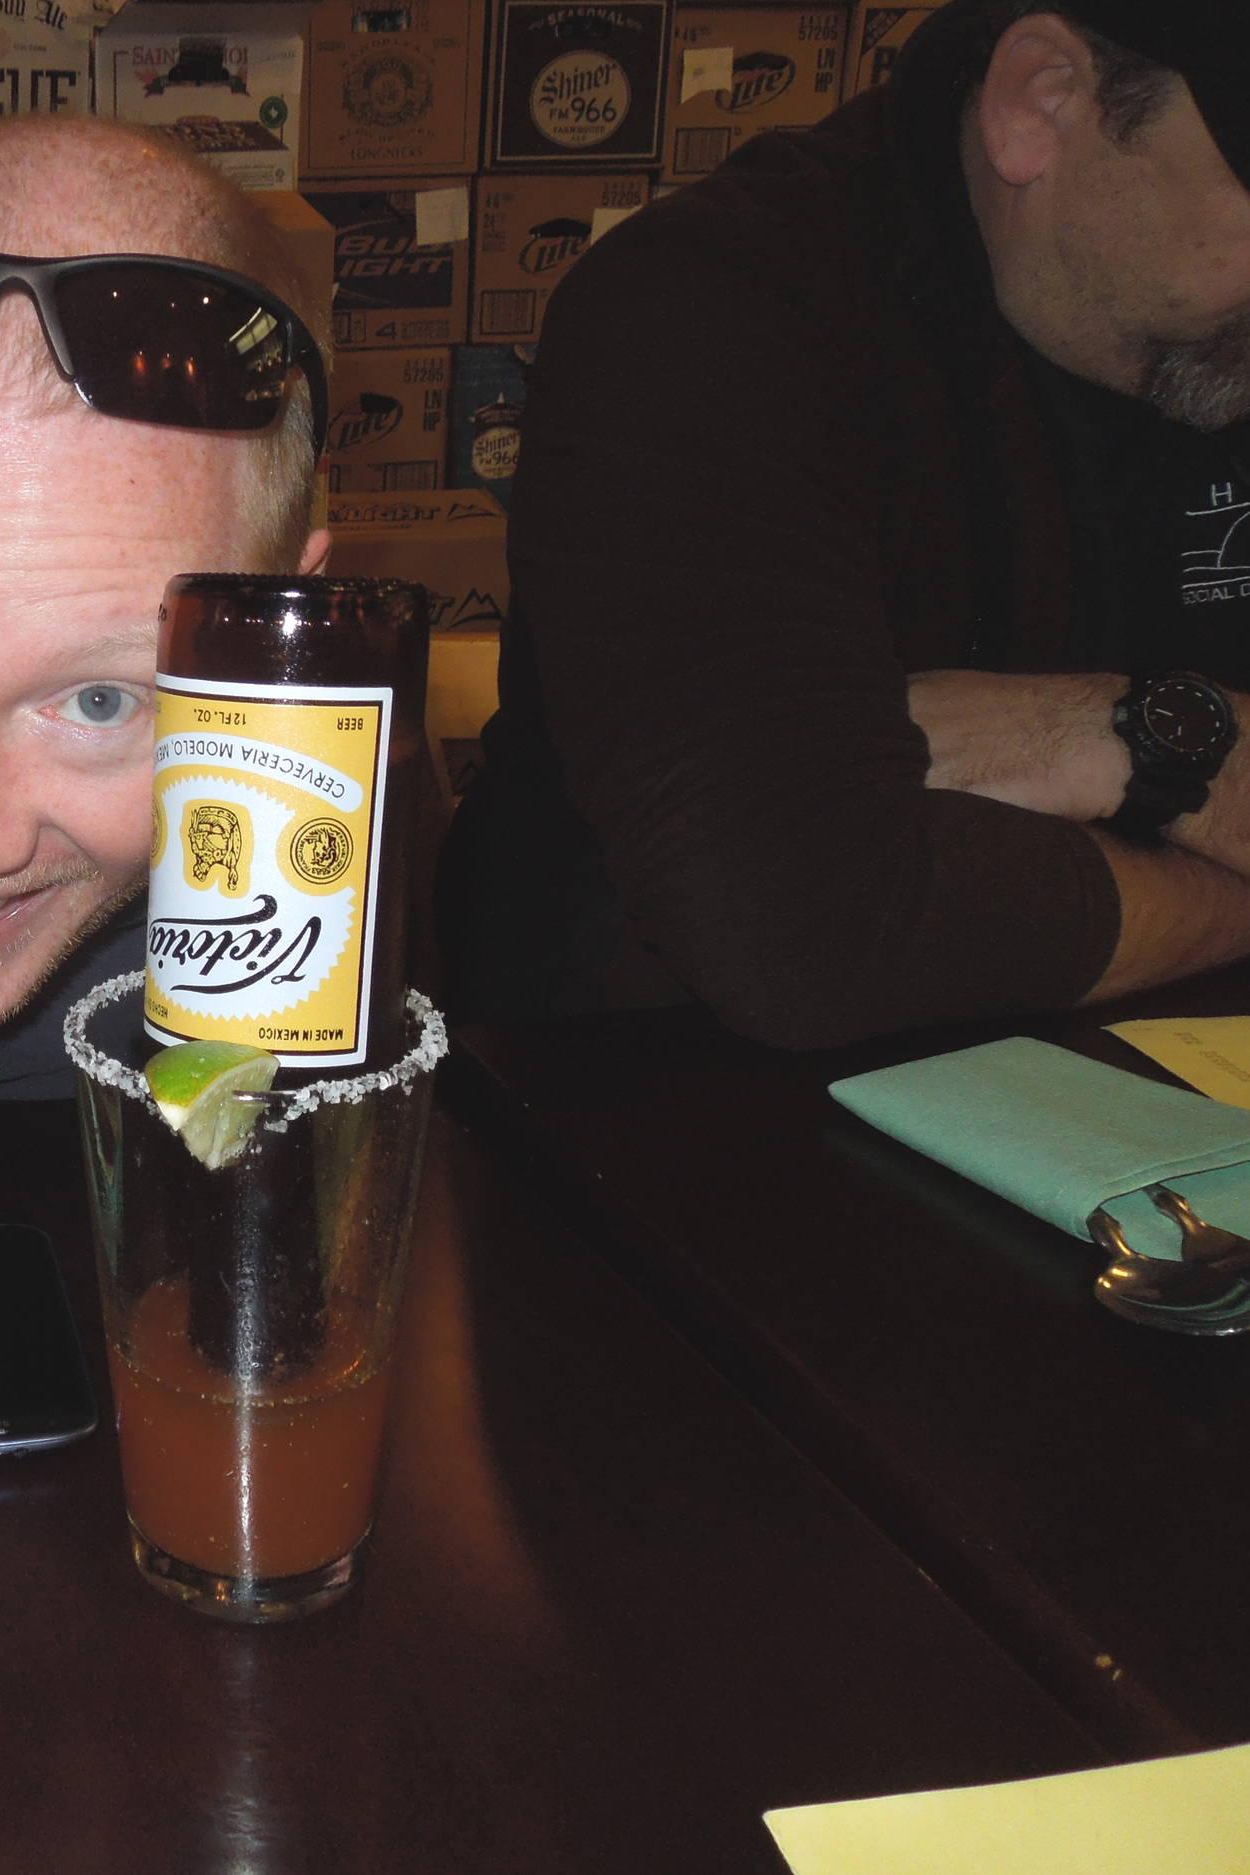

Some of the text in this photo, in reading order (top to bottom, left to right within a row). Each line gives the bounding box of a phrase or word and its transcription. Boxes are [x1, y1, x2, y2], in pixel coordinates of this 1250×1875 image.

[34, 0, 68, 30] Ale
[539, 64, 614, 105] Shiner
[549, 97, 617, 123] FM 966
[193, 708, 247, 726] 12 FL. OZ.
[337, 717, 364, 731] BEER
[171, 739, 234, 758] MODELO,
[240, 745, 346, 799] CERVECERIA
[149, 895, 322, 995] Victoria
[258, 1027, 344, 1041] MADE IN MEXICO
